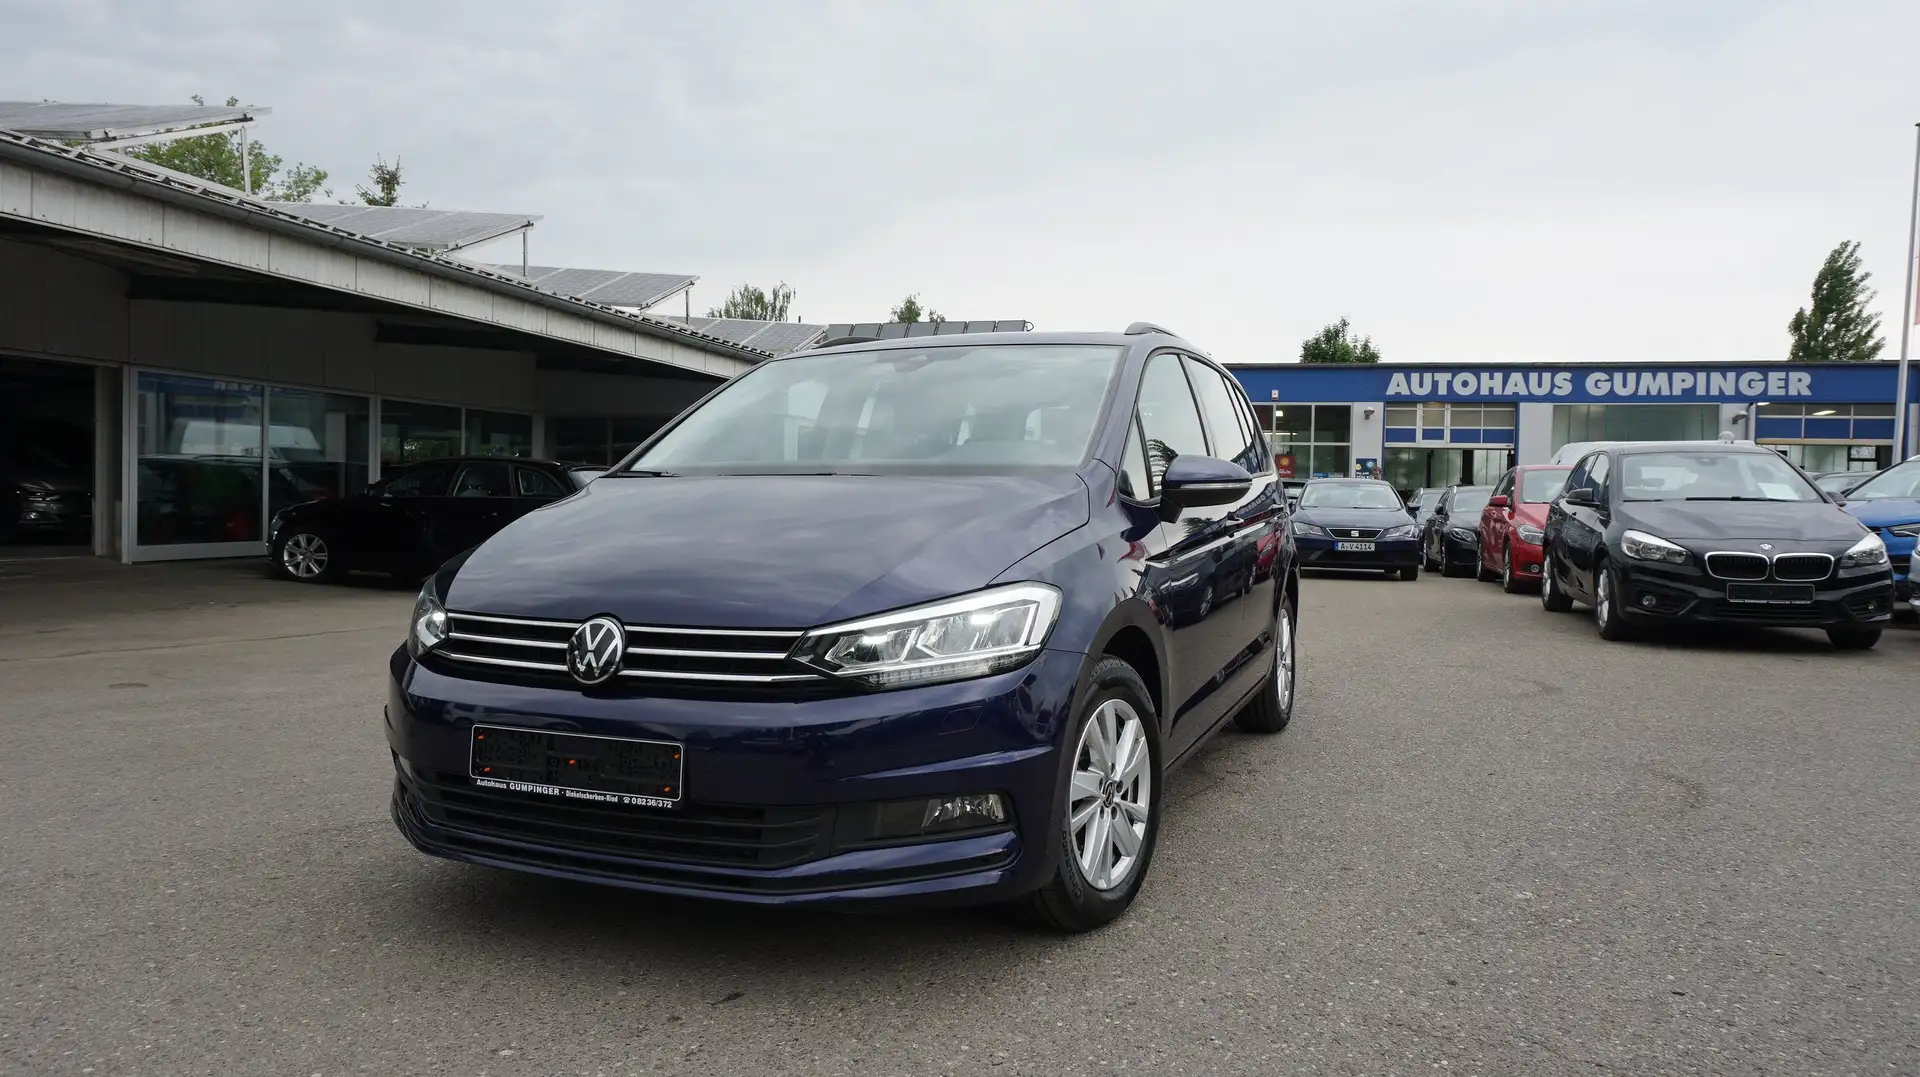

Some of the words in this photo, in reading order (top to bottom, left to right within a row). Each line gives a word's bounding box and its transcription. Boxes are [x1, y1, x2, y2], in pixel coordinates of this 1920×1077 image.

[1386, 372, 1573, 396] AUTOHAUS
[1585, 371, 1813, 397] GUMPINGER
[476, 779, 507, 789] Autohaus
[509, 782, 560, 796] GUMPINGER
[631, 796, 673, 809] 08236/372
